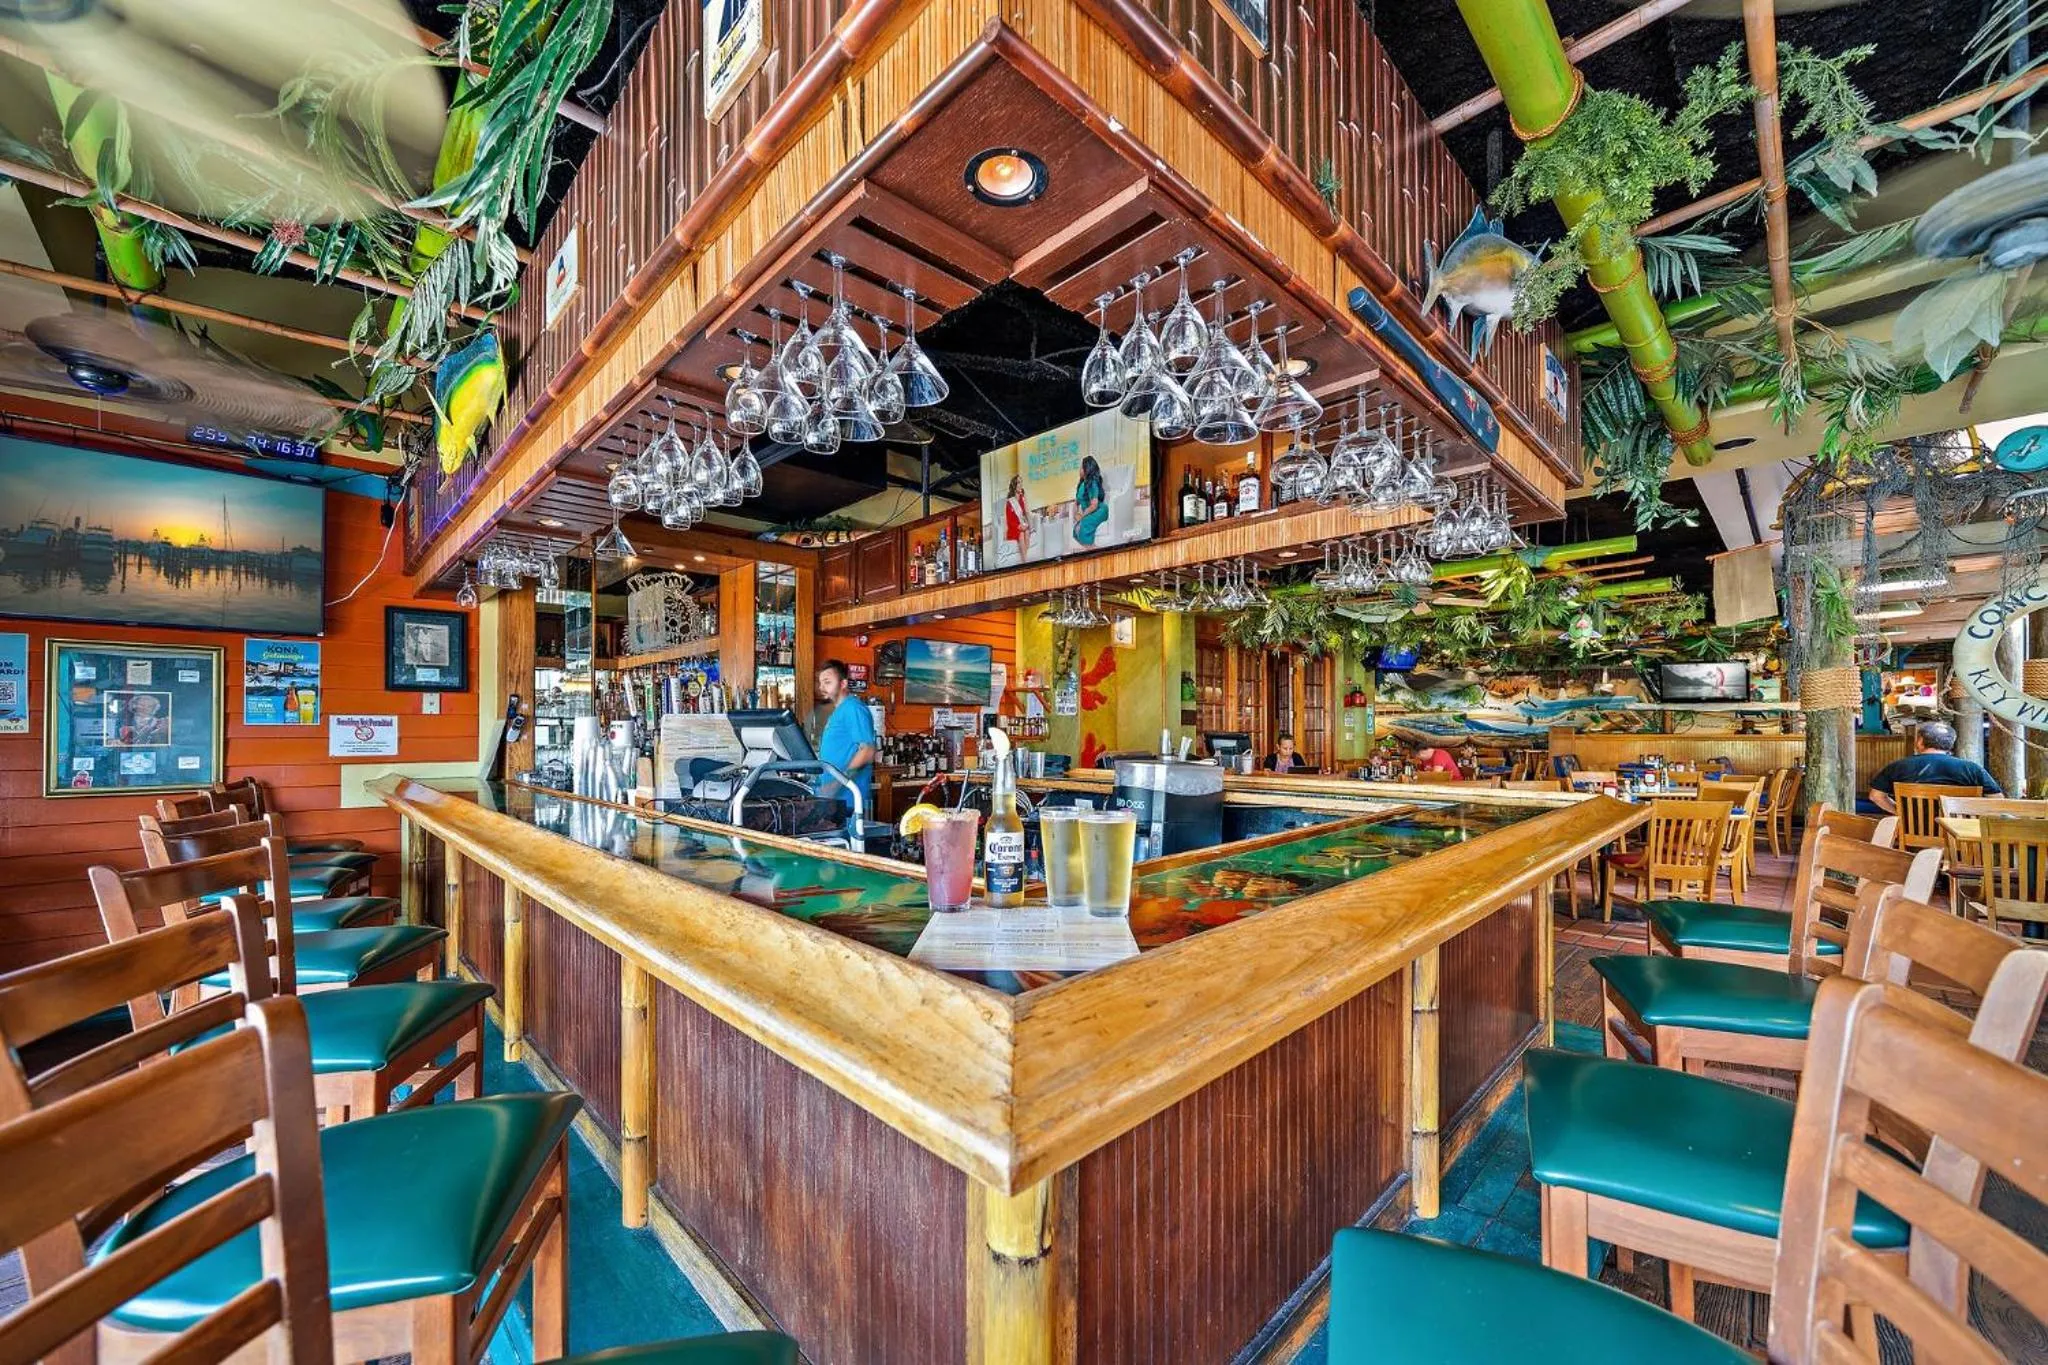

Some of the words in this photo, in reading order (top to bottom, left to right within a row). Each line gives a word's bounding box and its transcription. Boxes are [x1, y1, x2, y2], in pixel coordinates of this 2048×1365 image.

[1028, 440, 1080, 466] NEVER
[267, 645, 300, 655] KONA
[1968, 668, 2020, 705] KEY
